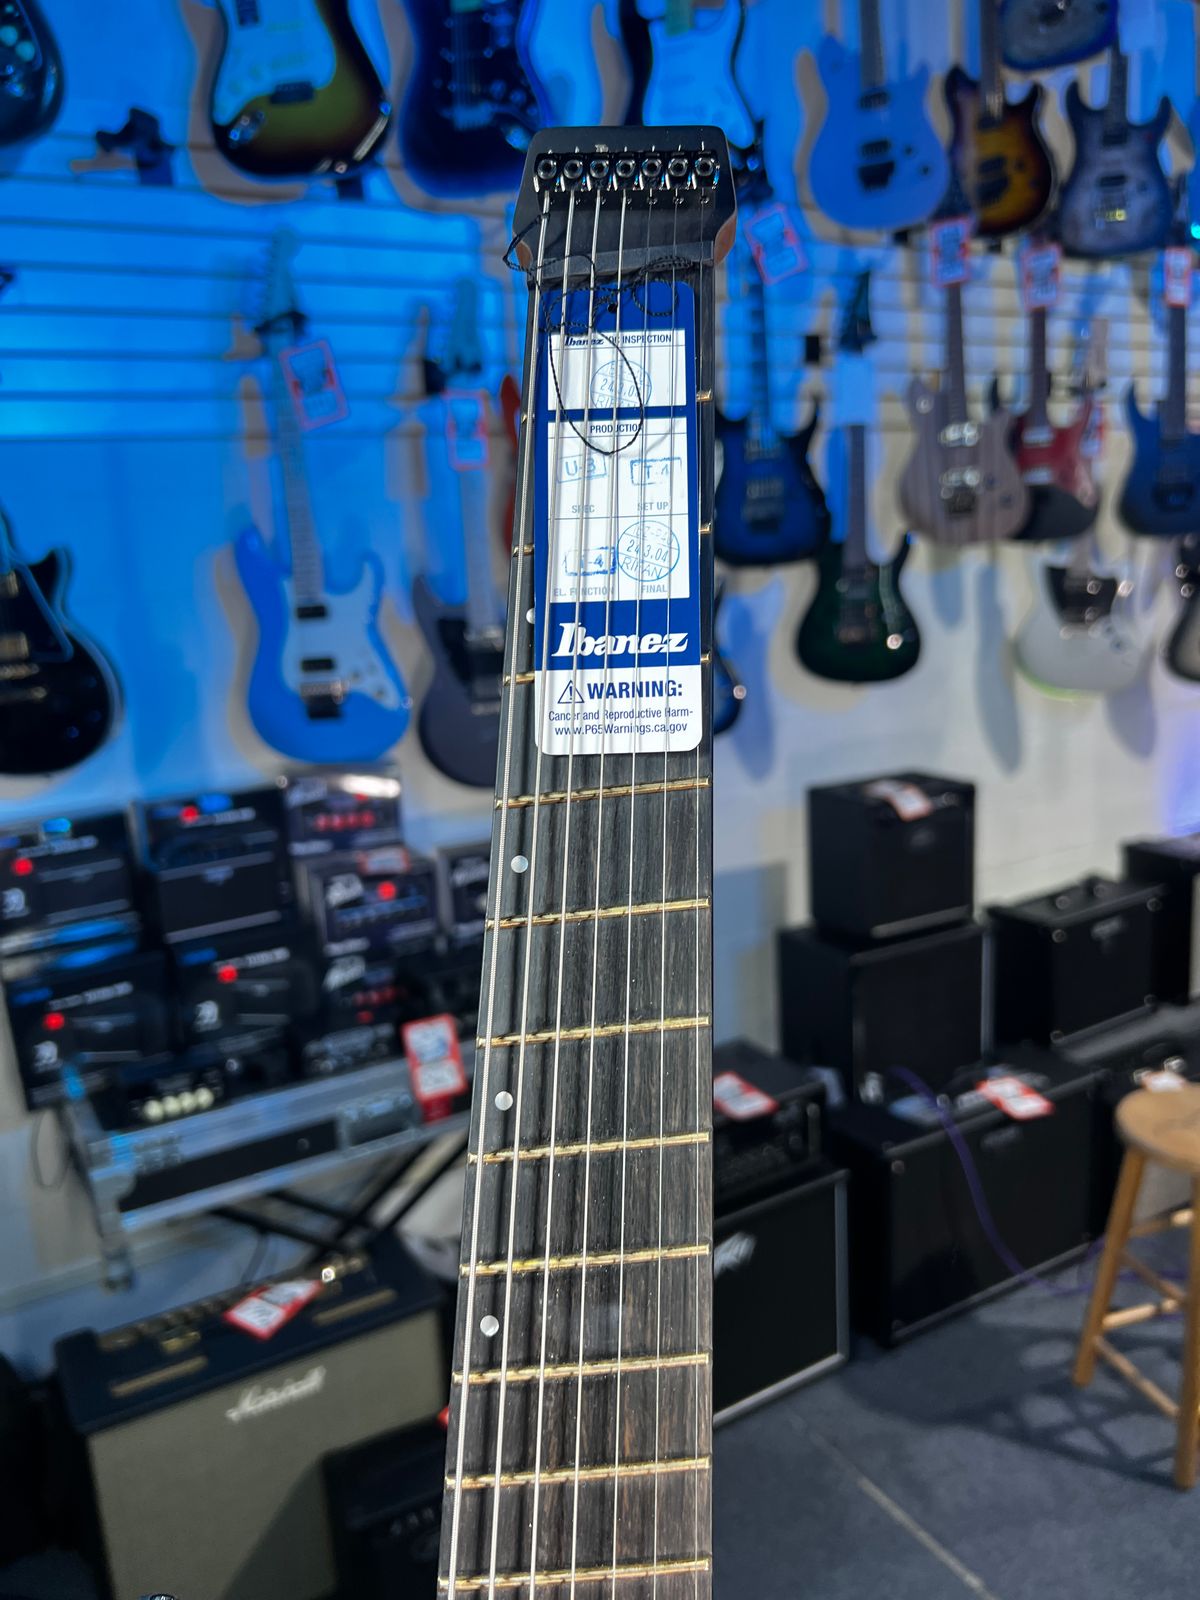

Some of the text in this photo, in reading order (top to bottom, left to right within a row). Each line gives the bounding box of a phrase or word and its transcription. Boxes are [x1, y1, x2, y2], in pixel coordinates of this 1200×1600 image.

[622, 334, 672, 345] INSPECTION
[590, 423, 642, 434] PRODUCTIO
[637, 501, 669, 511] SET UP
[569, 586, 615, 597] FNCTION
[641, 584, 669, 594] FINAL
[551, 622, 689, 657] Ibanez
[587, 679, 683, 700] WARNING:
[548, 706, 694, 722] Cancr and Reproductive Harm-
[554, 722, 688, 736] www.P65Warnings.ca.gov
